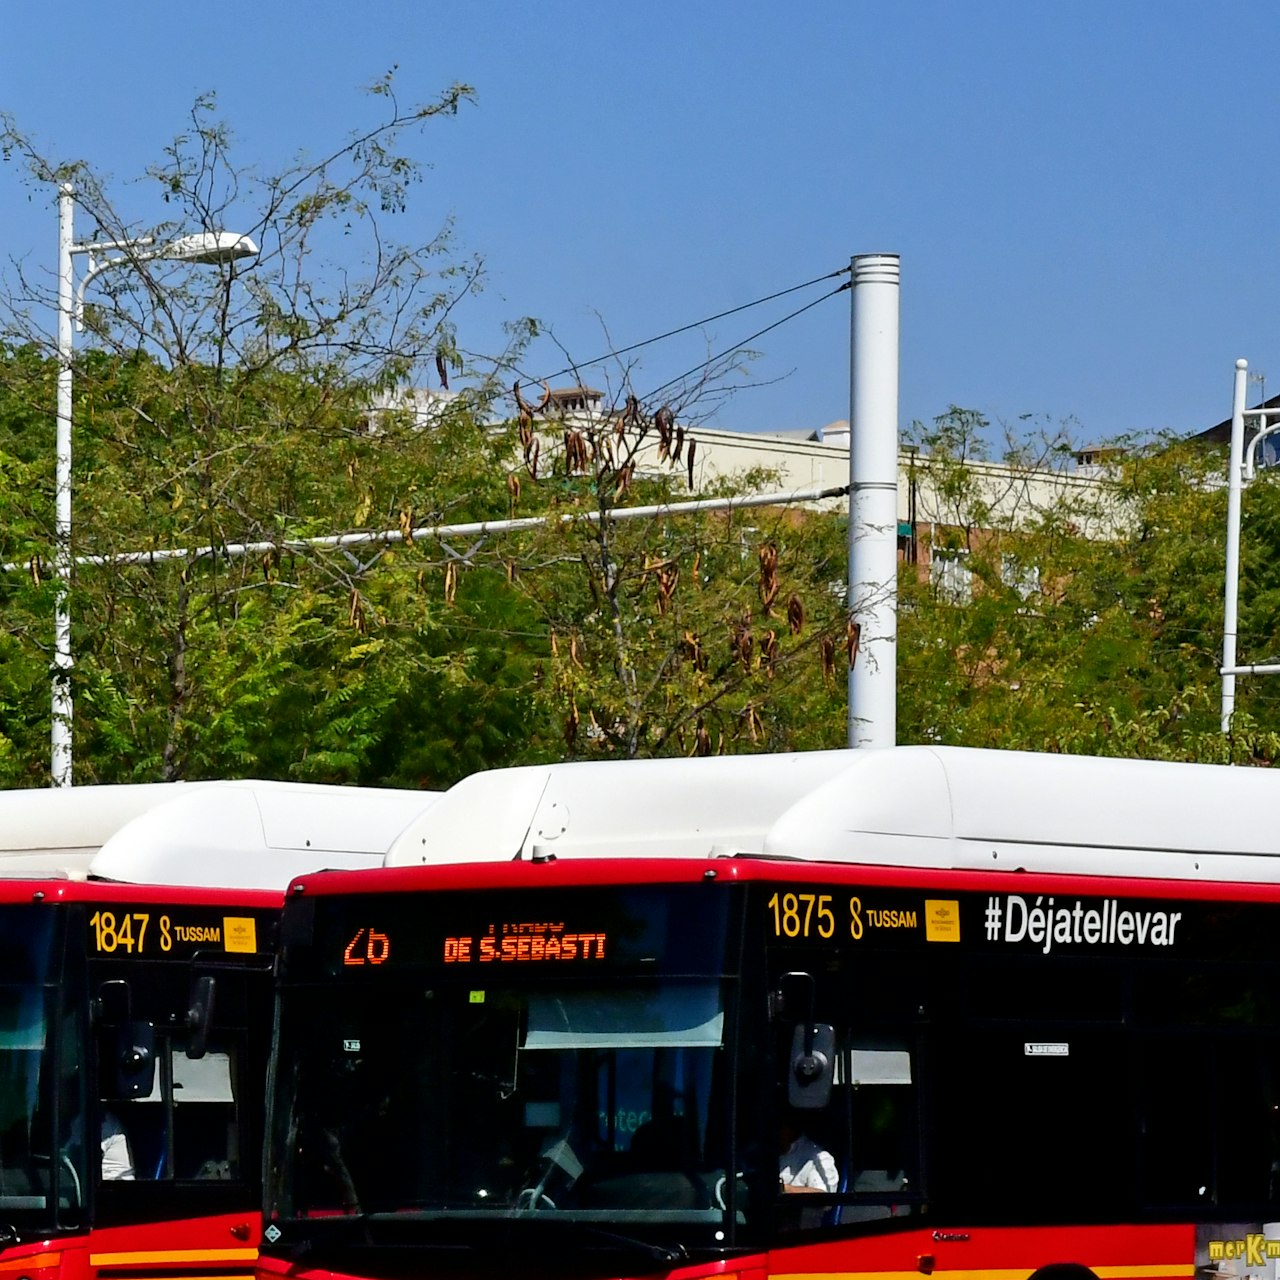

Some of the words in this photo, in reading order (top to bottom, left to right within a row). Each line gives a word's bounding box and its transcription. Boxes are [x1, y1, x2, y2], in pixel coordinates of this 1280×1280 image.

[90, 911, 149, 953] 1847
[174, 926, 220, 942] TUSSAM
[768, 892, 835, 938] 1875
[866, 909, 917, 928] TUSSAM
[984, 895, 1182, 954] #Déjatellevar
[444, 937, 472, 962] DE
[479, 933, 606, 961] S.SEBASTI
